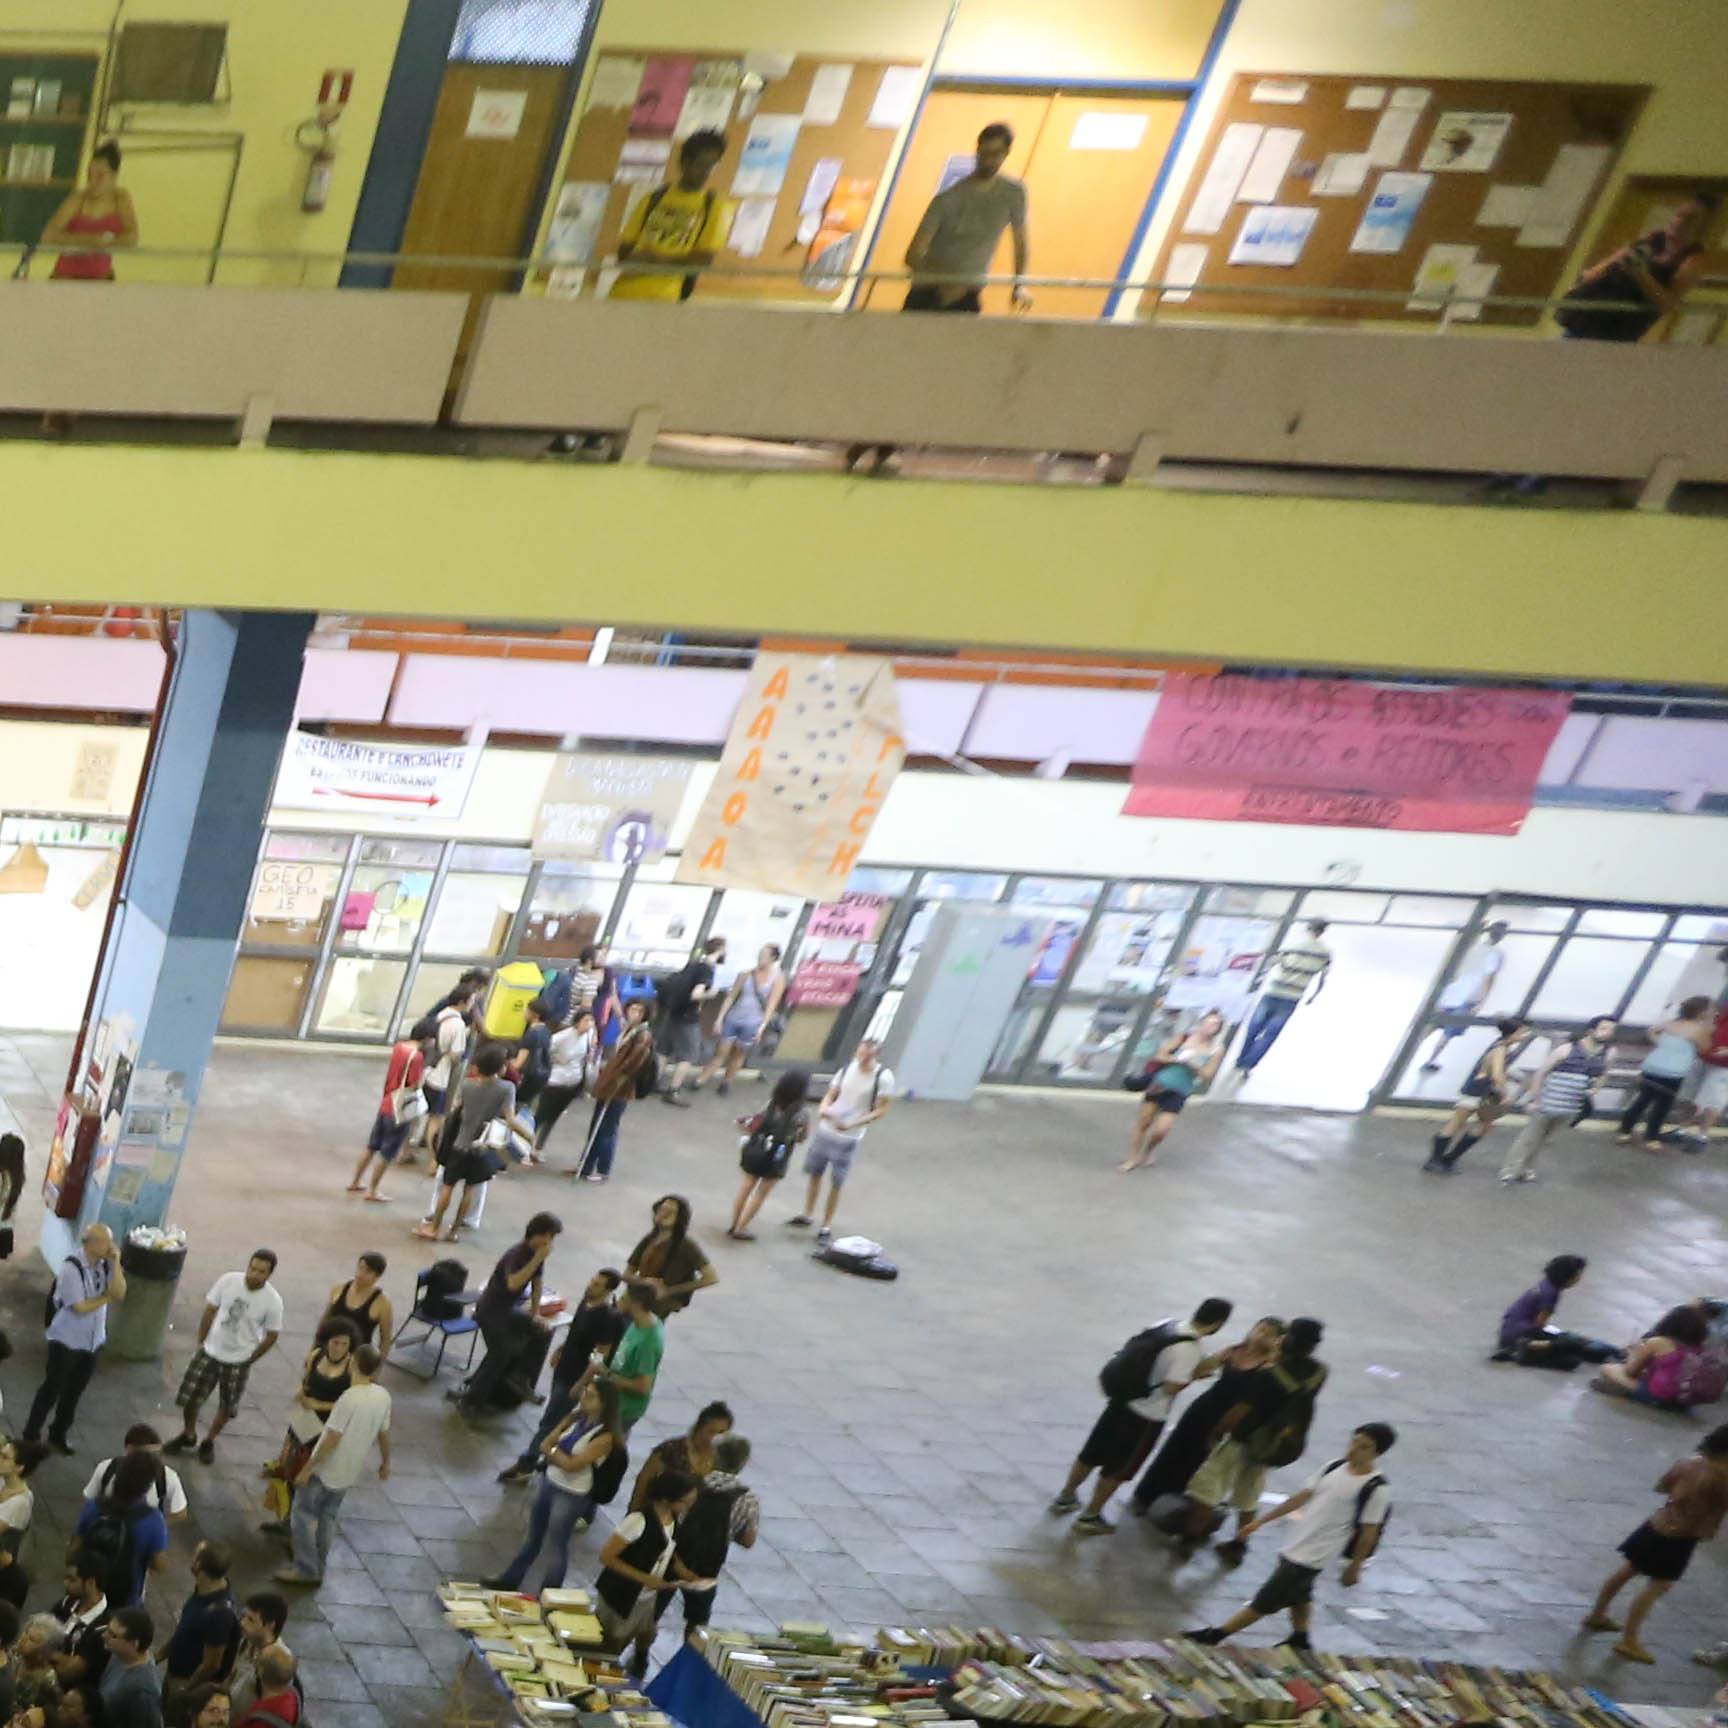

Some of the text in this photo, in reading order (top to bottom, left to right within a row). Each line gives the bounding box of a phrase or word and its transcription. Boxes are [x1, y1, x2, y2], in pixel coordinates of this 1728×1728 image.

[1174, 721, 1334, 772] GOVERNOS
[262, 864, 314, 885] GEO
[812, 921, 866, 937] MINA
